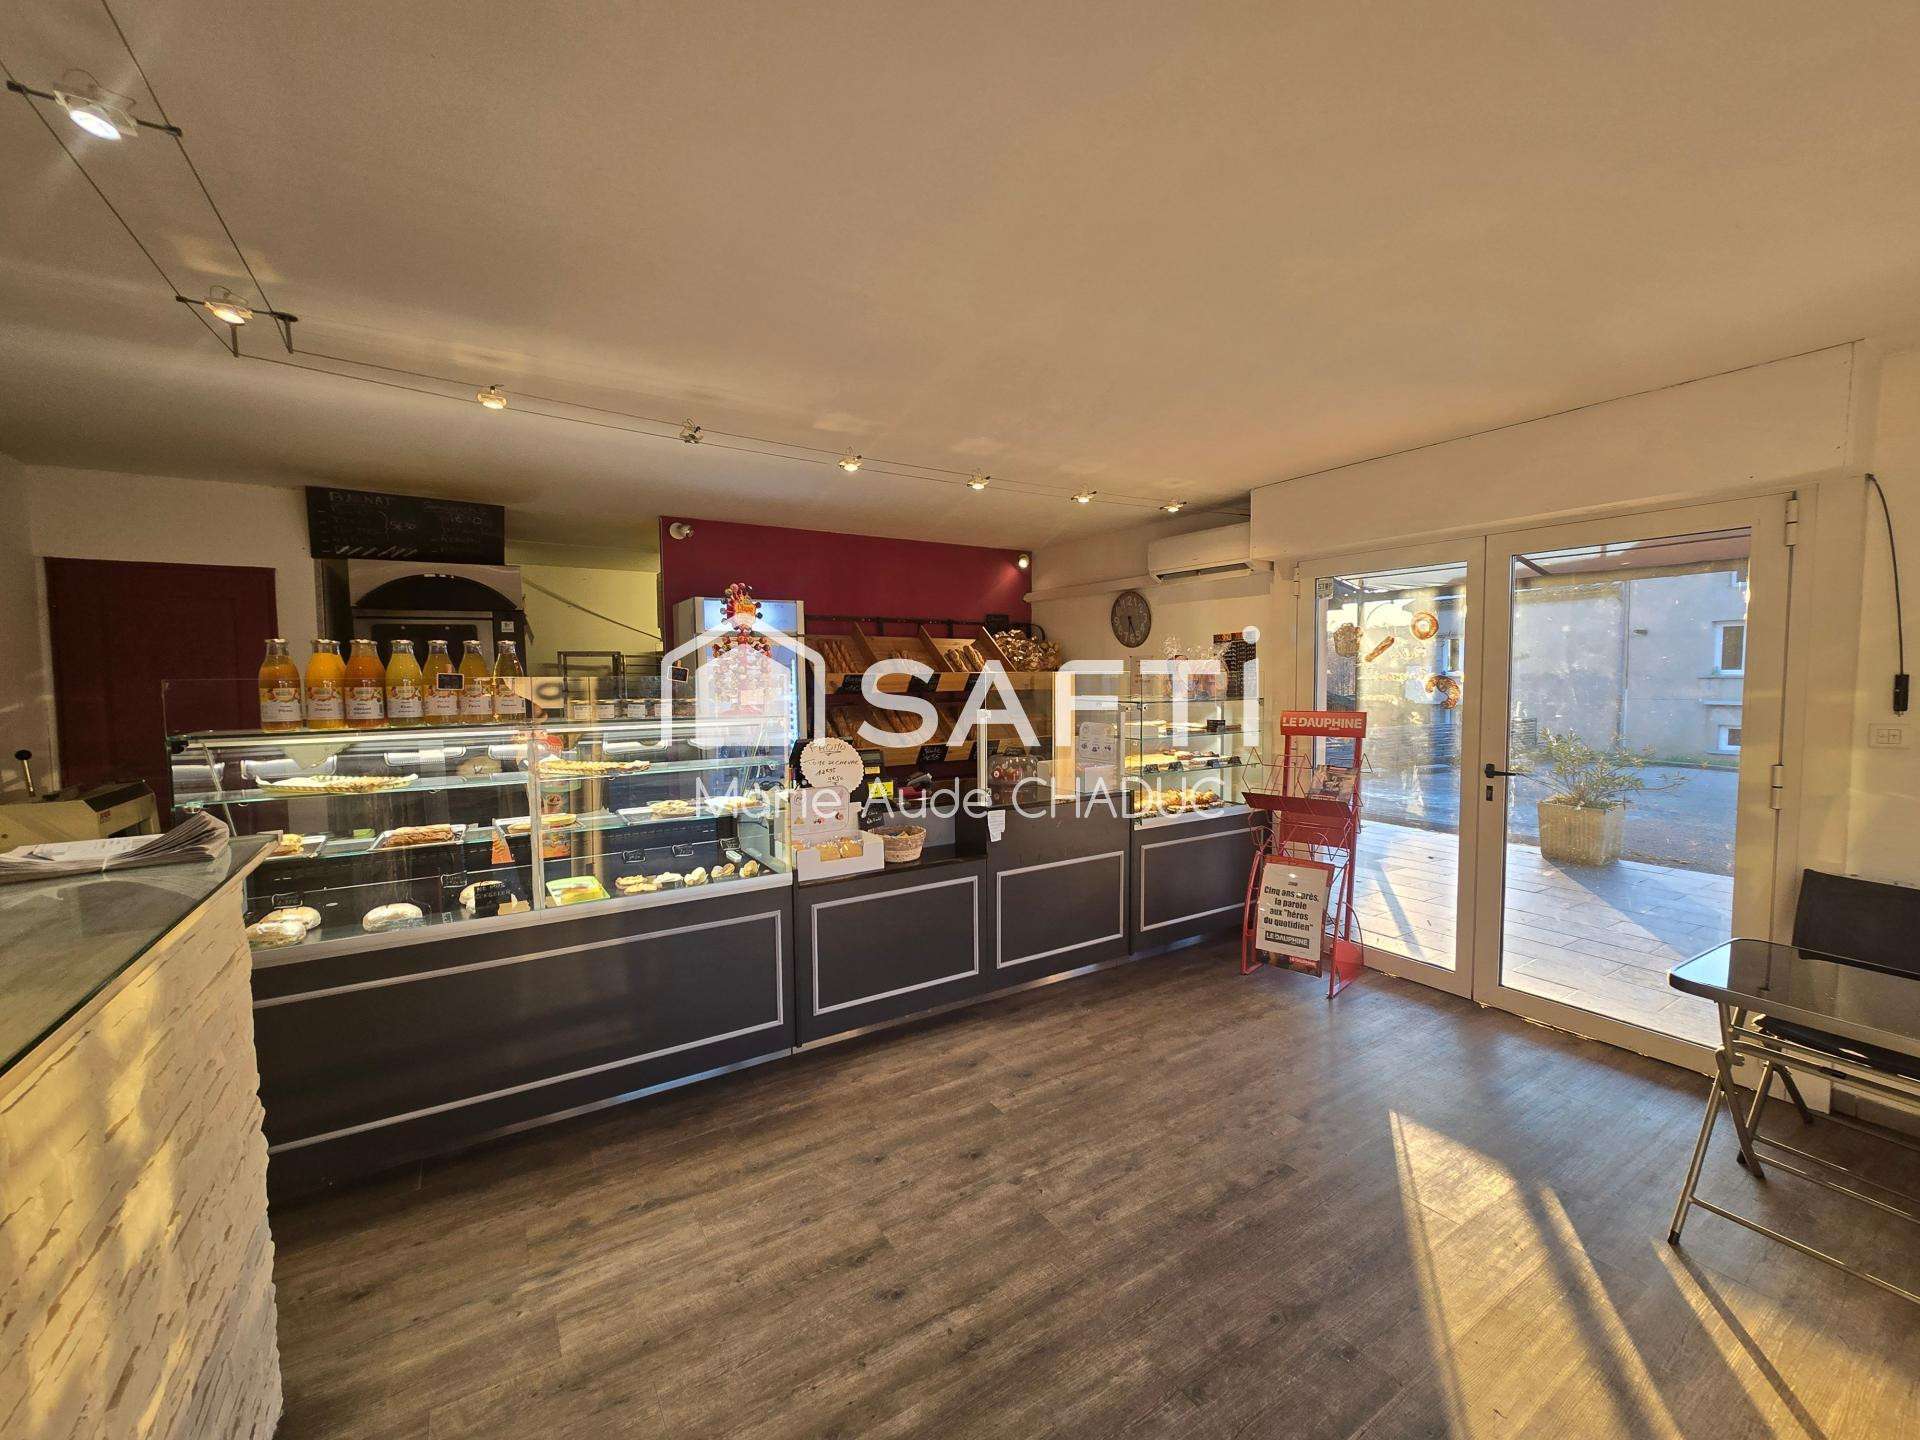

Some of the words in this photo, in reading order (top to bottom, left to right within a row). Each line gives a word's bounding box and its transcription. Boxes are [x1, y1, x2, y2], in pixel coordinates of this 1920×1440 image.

[1282, 716, 1297, 727] LE
[1264, 885, 1281, 897] Cinq
[1281, 888, 1295, 898] ans
[1274, 897, 1282, 906] la
[1282, 898, 1308, 910] parole
[1269, 907, 1283, 917] aux
[1264, 915, 1273, 924] du
[1274, 919, 1314, 931] quotidien"
